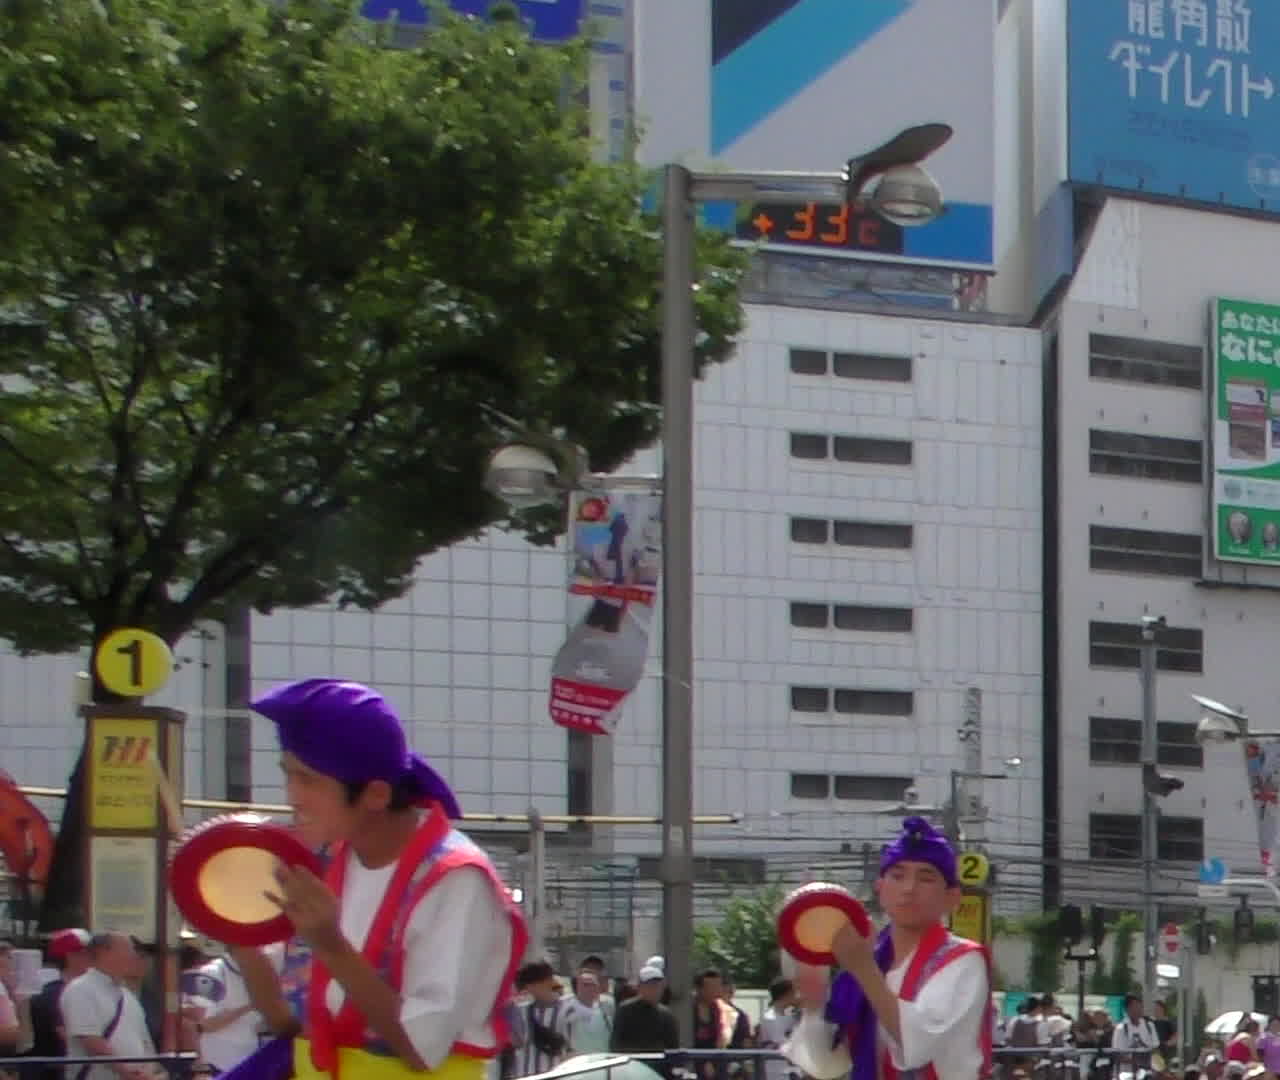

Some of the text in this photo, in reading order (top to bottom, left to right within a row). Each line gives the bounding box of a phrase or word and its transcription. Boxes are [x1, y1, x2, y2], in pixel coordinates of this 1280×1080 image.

[1108, 41, 1275, 119] ダイレクト
[116, 639, 143, 688] 1
[962, 863, 980, 888] 2
